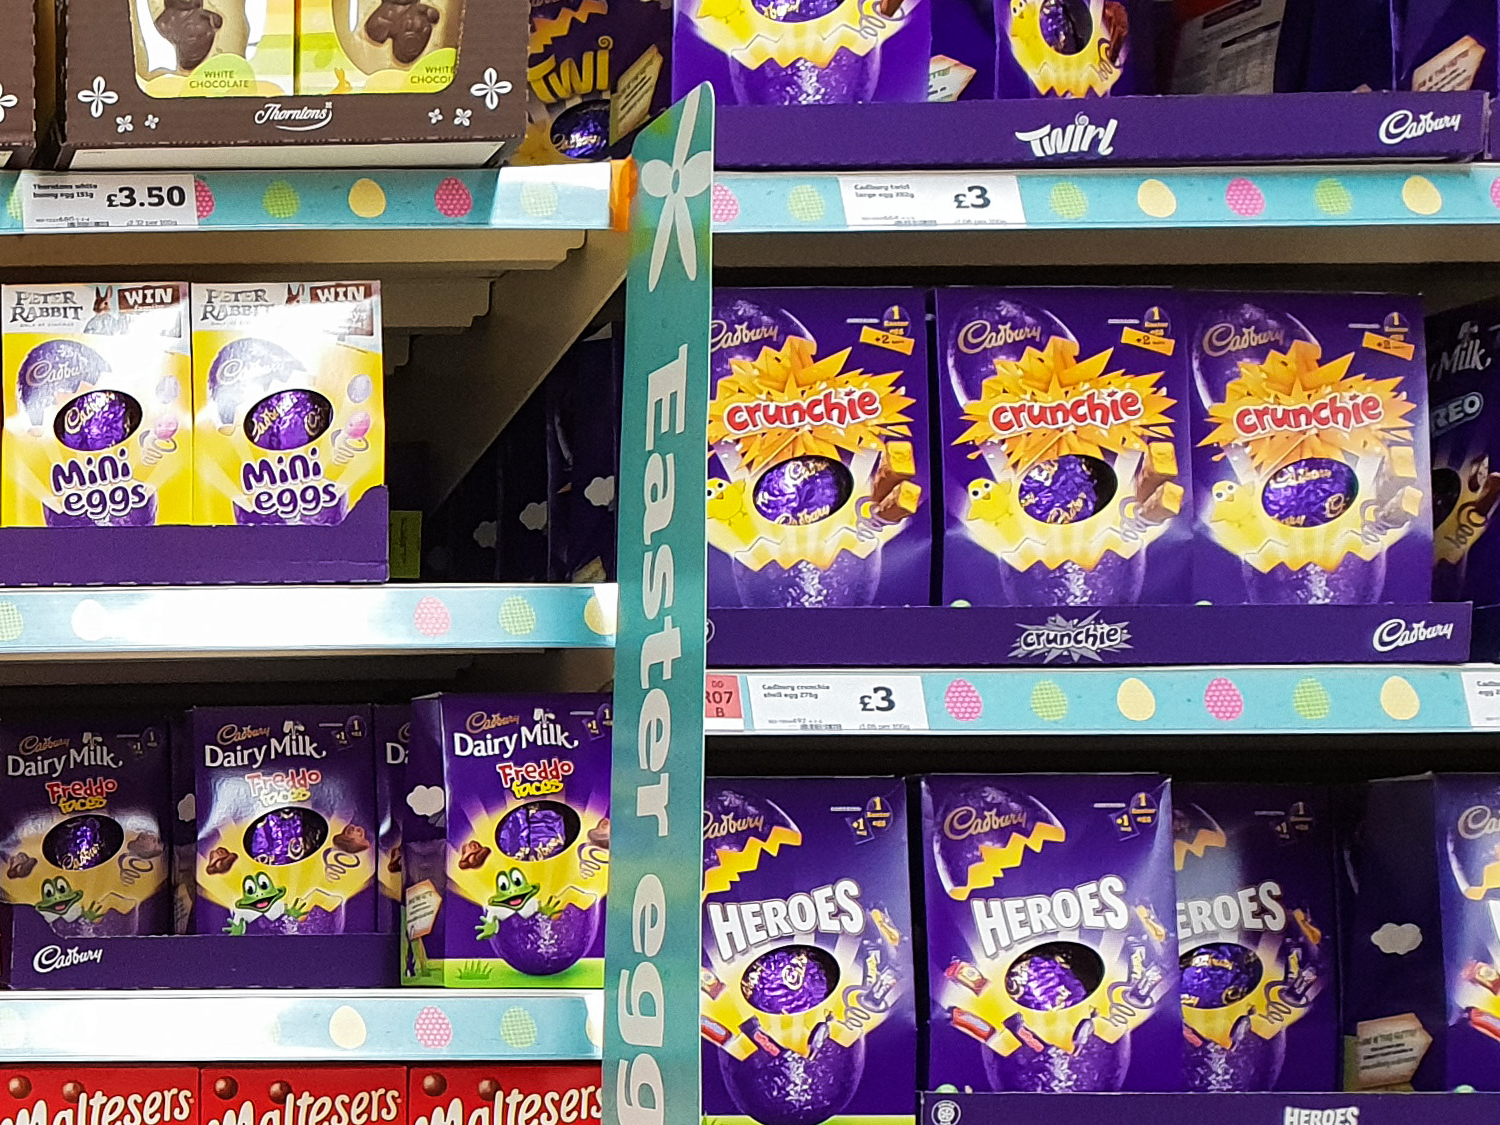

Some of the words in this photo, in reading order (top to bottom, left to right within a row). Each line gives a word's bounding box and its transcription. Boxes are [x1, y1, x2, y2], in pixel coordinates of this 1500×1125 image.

[189, 79, 249, 89] CHOCOLATE
[204, 70, 234, 79] WHITE
[255, 102, 332, 131] Thorntons
[1379, 110, 1461, 144] Cadbury
[1015, 112, 1118, 157] Twirl
[106, 186, 186, 208] £3.50
[953, 185, 991, 209] £3
[959, 319, 1041, 354] Cadbury
[726, 388, 881, 433] crunchie
[1235, 391, 1385, 436] crunchie
[635, 346, 687, 836] Easter
[1021, 622, 1121, 651] crunchie
[1373, 619, 1453, 652] Cadbury
[859, 687, 895, 712] £3
[454, 733, 518, 758] Dairy
[521, 724, 572, 748] Milk
[497, 758, 574, 786] Freddo
[943, 808, 1027, 840] Cadbury
[971, 876, 1129, 959] HEROES
[33, 945, 103, 974] Cadbury
